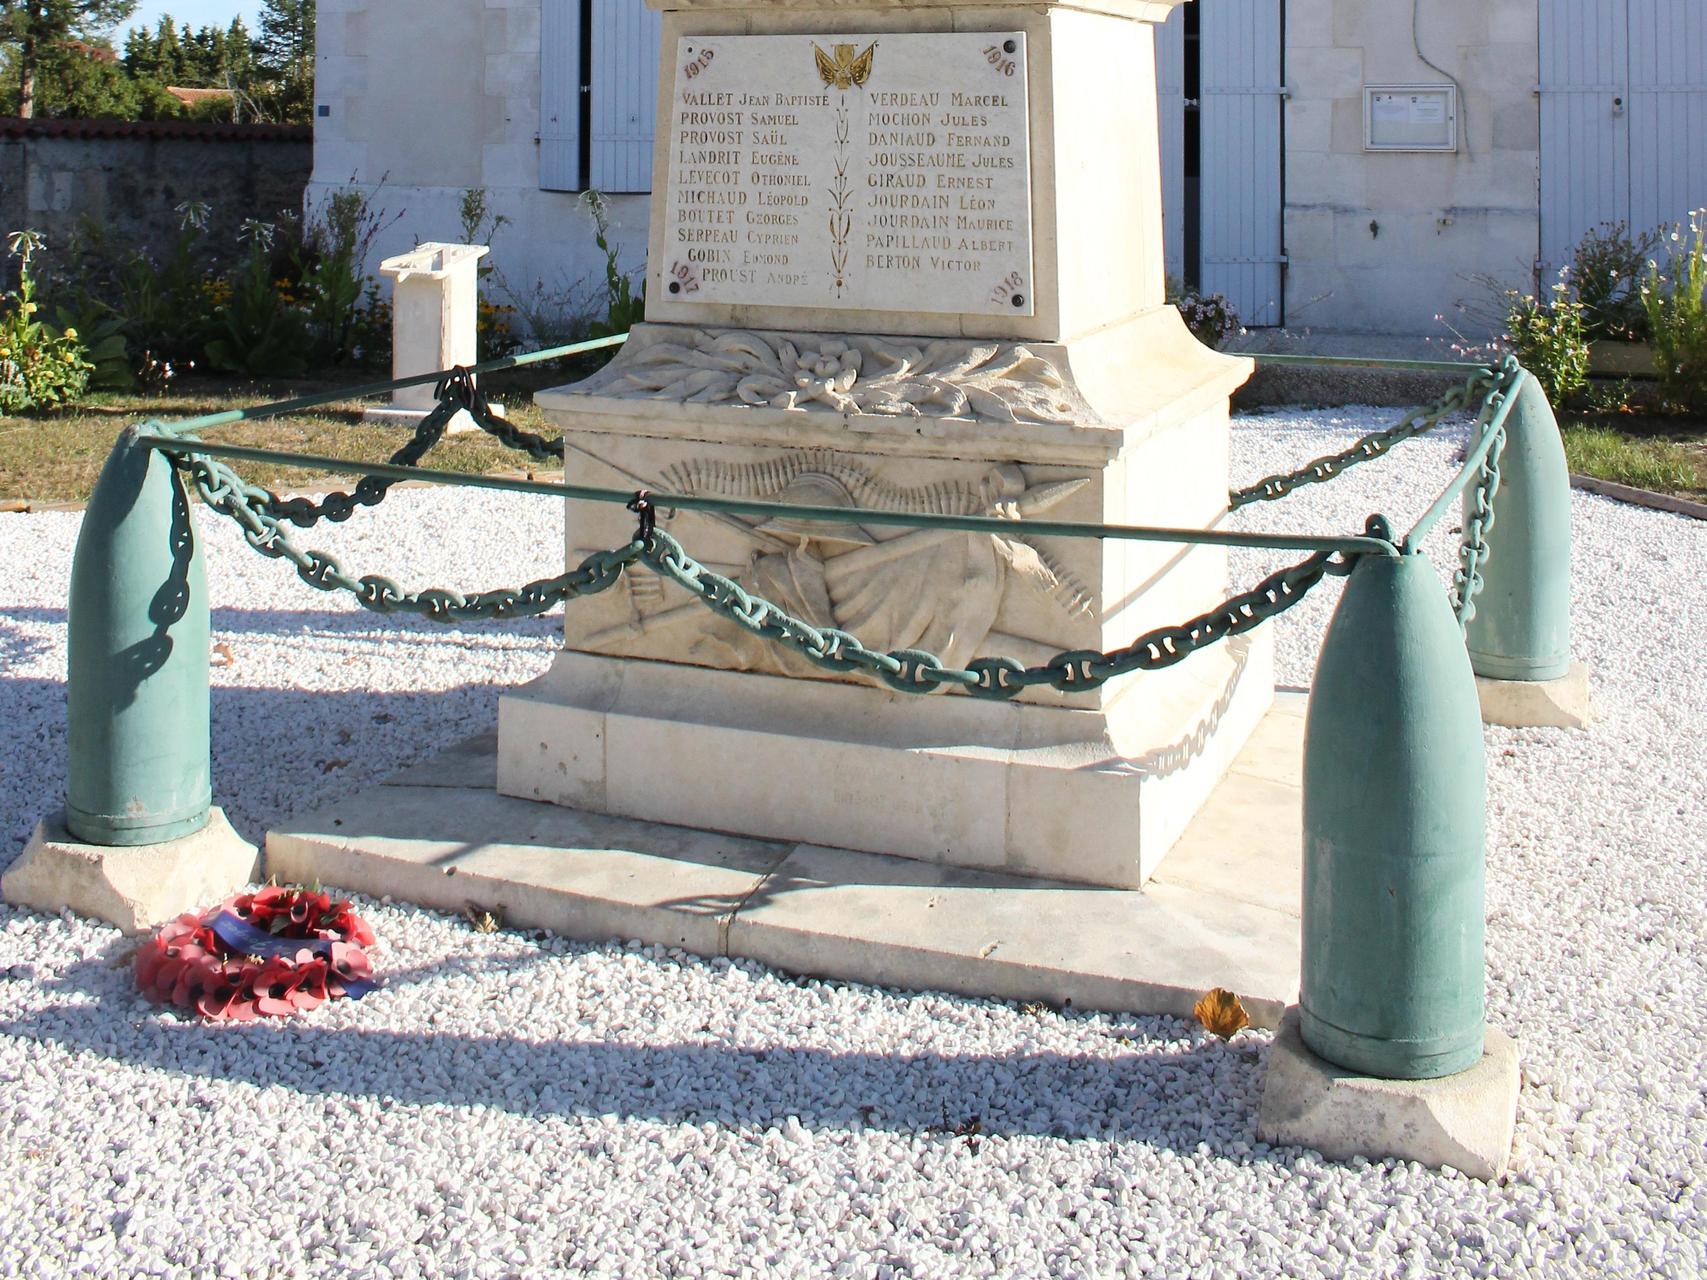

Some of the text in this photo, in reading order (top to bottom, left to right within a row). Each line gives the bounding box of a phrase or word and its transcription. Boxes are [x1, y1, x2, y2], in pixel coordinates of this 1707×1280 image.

[683, 49, 715, 79] 1915
[982, 45, 1016, 77] 1916
[682, 93, 733, 106] VALLET
[870, 93, 939, 107] VERDEAU
[680, 112, 744, 125] PROVOST
[868, 113, 931, 126] MOCHON
[680, 131, 744, 145] PROVOST
[868, 133, 936, 147] DANIAUD
[679, 151, 741, 164] LANDRIT
[868, 153, 966, 167] JOUSSEAUME
[679, 170, 741, 185] LEVECOT
[867, 174, 926, 189] GIRAUD
[677, 190, 748, 205] MICHAUD
[867, 195, 950, 209] JOURDAIN
[677, 209, 735, 224] BOUTET
[867, 215, 949, 229] JOURDAIN
[677, 229, 738, 243] SERPEAU
[866, 235, 951, 250] PAPILLAUD
[687, 248, 732, 262] GOBIN
[866, 255, 920, 269] BERTON
[669, 261, 700, 294] 1917
[702, 268, 757, 283] PROUST
[991, 271, 1023, 305] 1918
